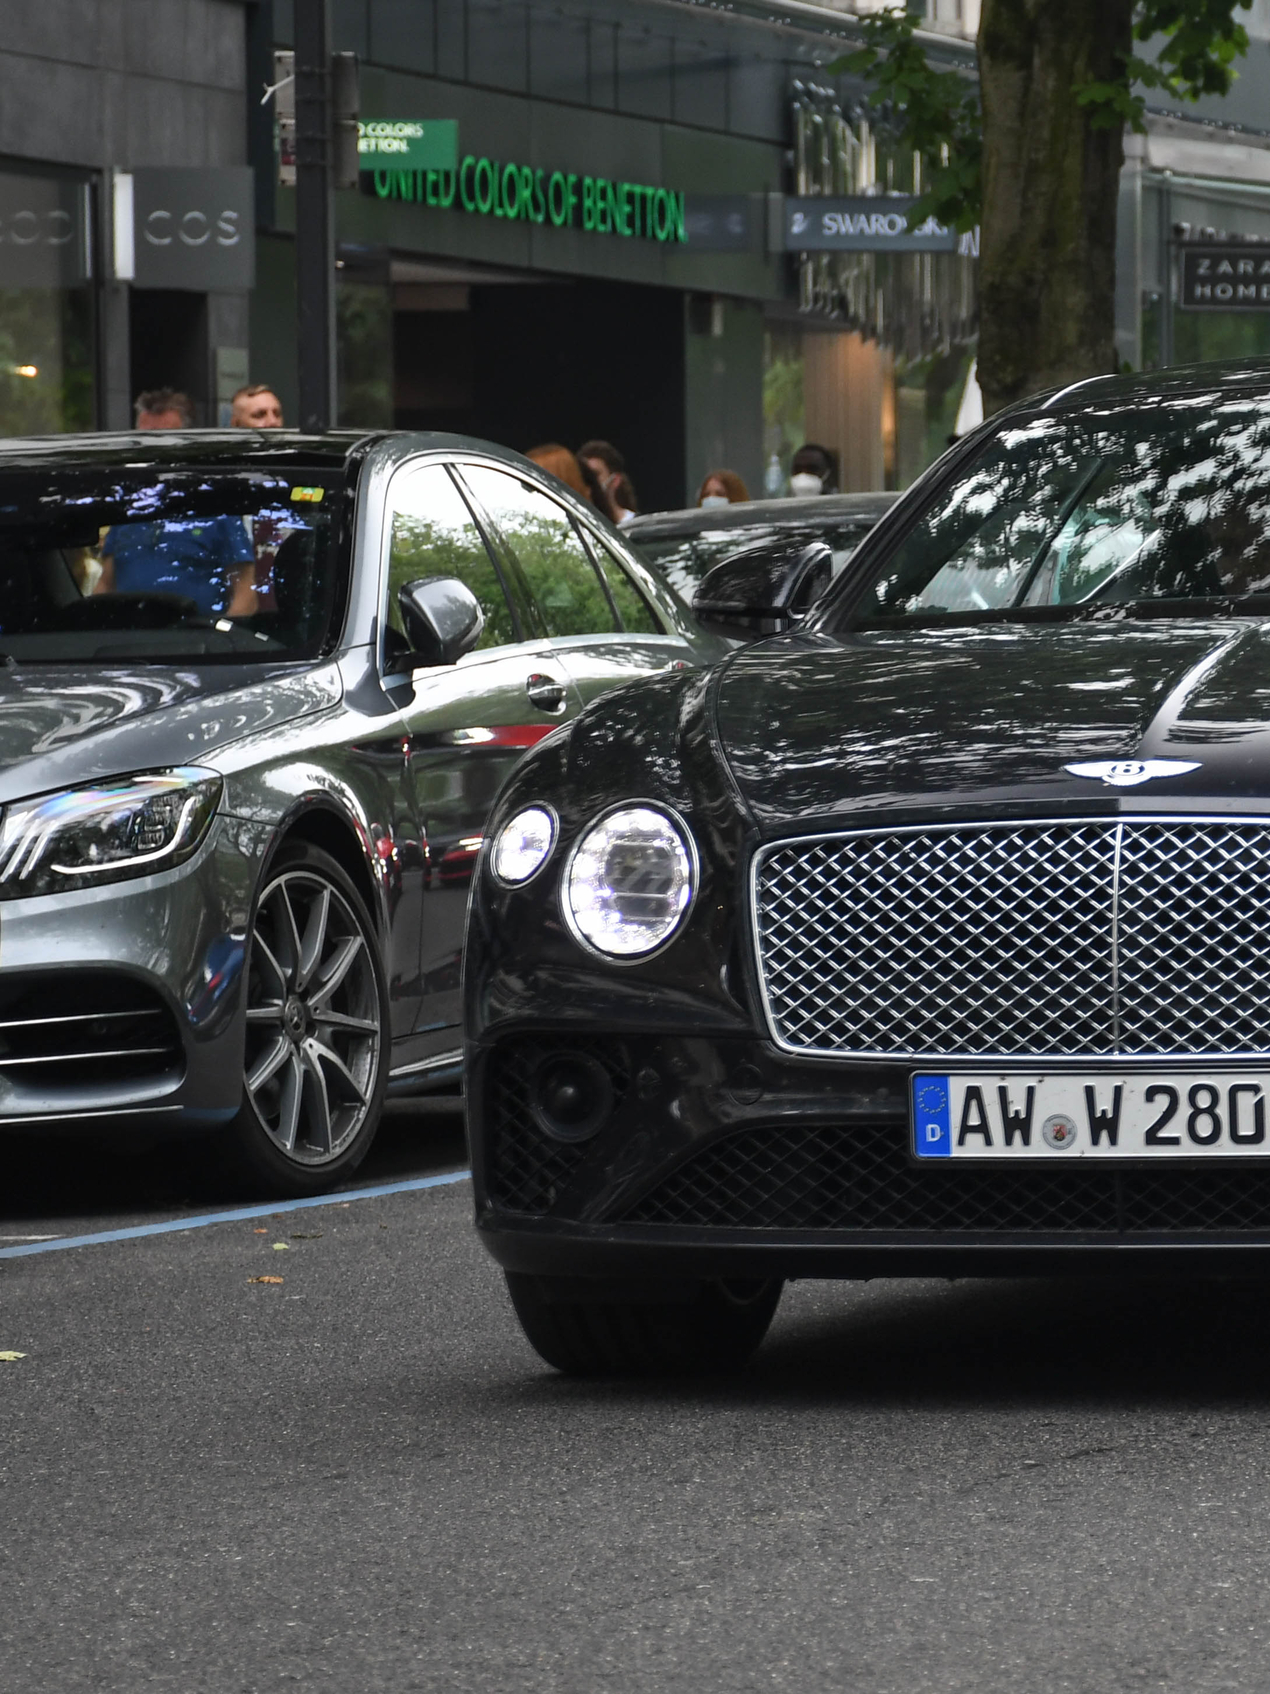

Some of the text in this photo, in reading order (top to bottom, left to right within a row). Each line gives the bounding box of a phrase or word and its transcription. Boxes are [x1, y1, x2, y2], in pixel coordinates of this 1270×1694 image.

[366, 122, 424, 138] COLORS
[460, 155, 546, 224] COLORS
[550, 171, 578, 226] OF
[143, 210, 241, 246] COS
[957, 1084, 1037, 1146] AW
[1084, 1083, 1124, 1146] W
[926, 1124, 941, 1142] D
